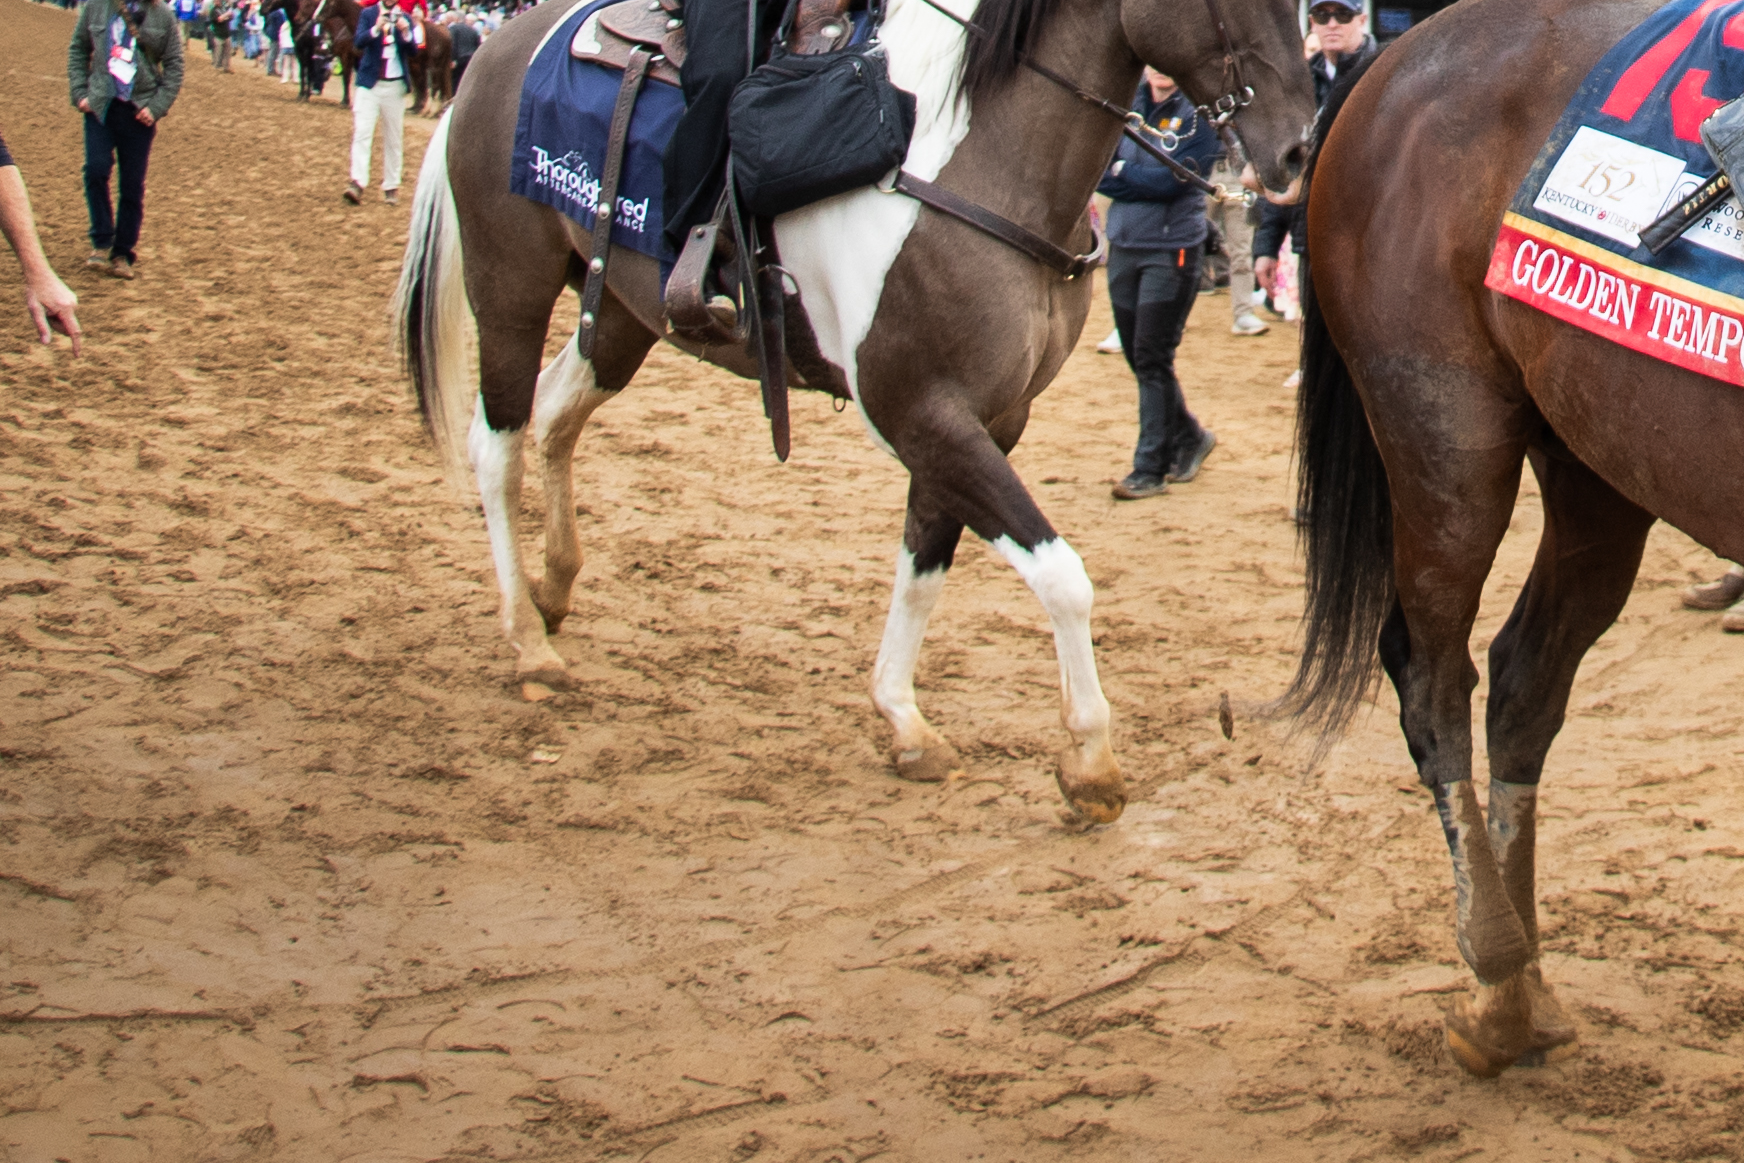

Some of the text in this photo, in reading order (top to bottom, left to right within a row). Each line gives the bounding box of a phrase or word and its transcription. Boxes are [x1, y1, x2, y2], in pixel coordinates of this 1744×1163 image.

[1541, 186, 1598, 218] KENTUCKY
[1577, 160, 1637, 202] 152
[1510, 238, 1643, 331] GOLDEN
